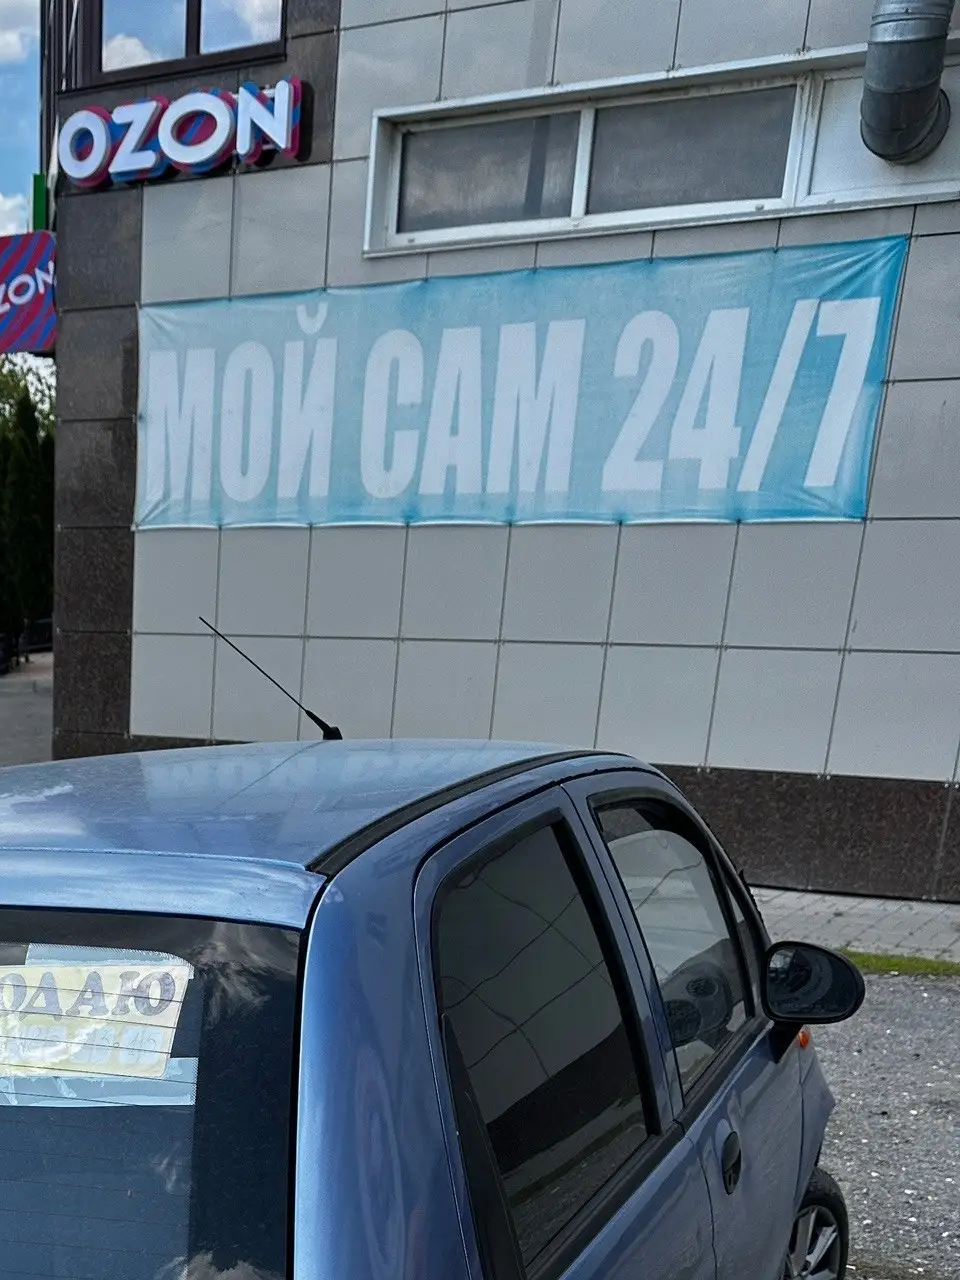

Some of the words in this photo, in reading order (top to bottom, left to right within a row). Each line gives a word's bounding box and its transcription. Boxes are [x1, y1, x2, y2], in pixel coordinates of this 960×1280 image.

[58, 80, 291, 179] OZON
[147, 302, 337, 501] МОЙ
[360, 318, 586, 498] САМ
[601, 297, 881, 492] 24/7
